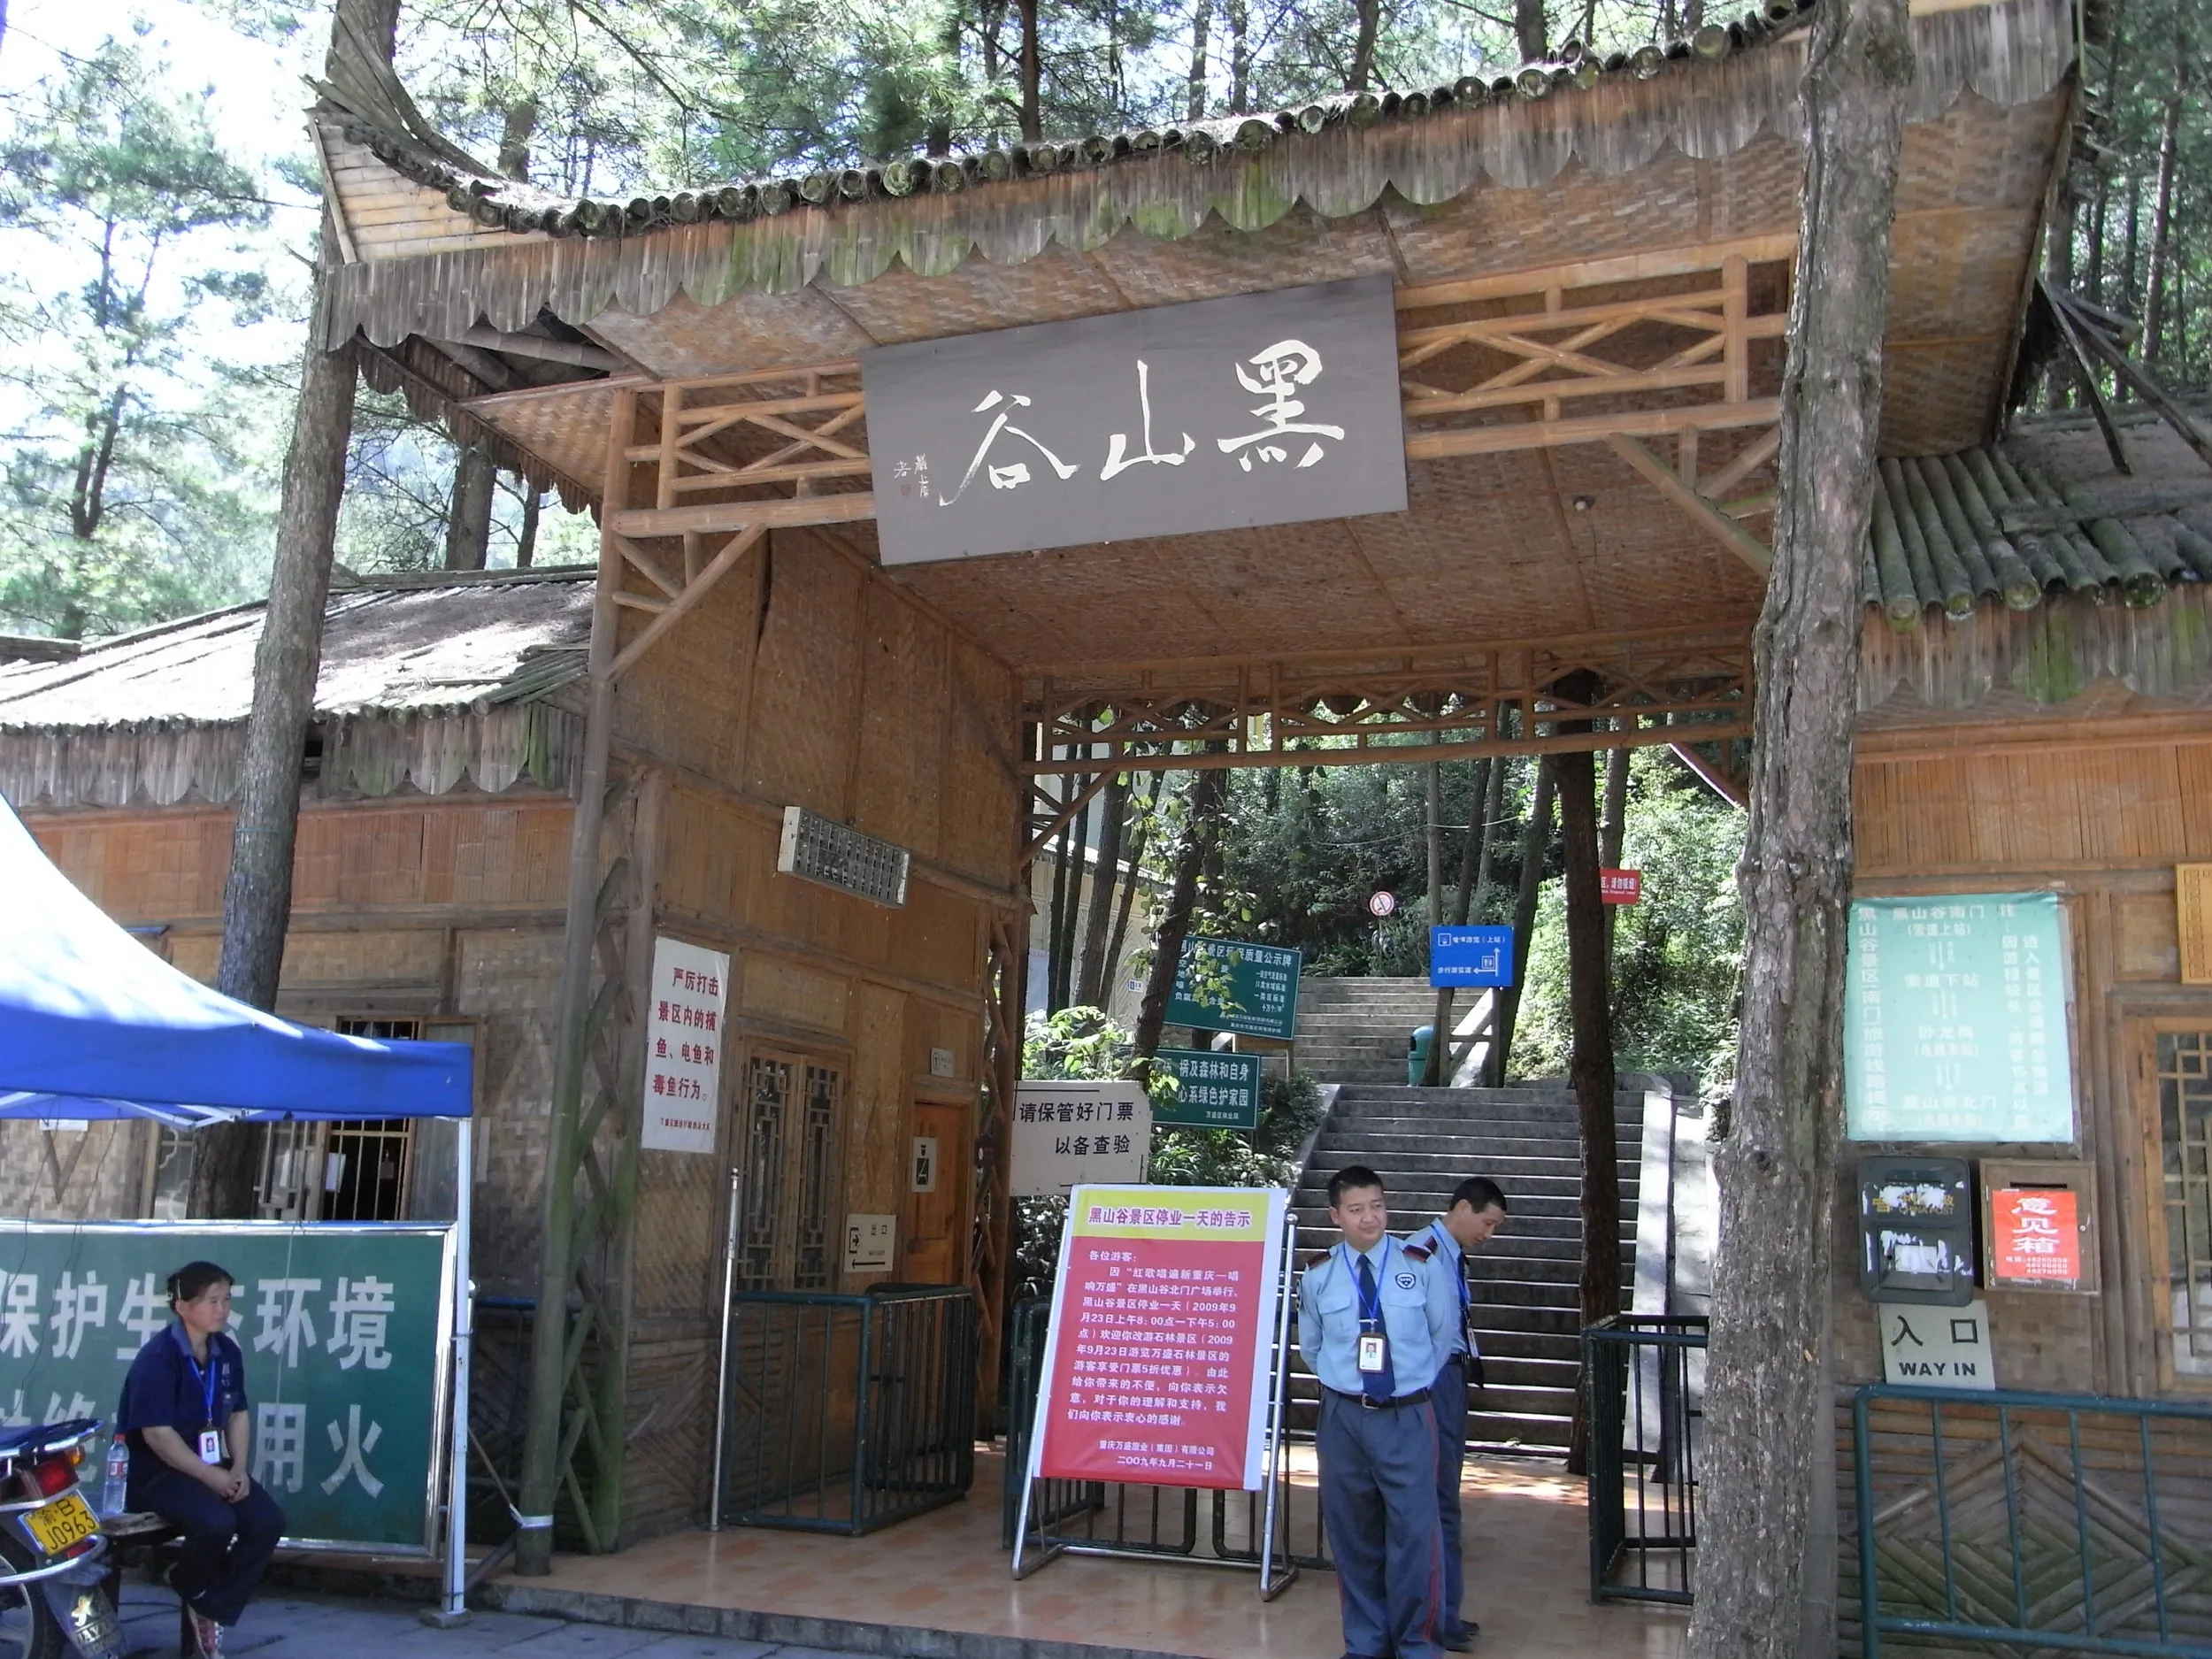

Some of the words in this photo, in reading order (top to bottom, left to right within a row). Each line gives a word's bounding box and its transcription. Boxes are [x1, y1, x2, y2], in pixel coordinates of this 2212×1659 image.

[939, 339, 1345, 507] 黑山谷
[672, 967, 718, 997] 严厉打击
[658, 1001, 717, 1032] 景区内的捕
[656, 1037, 714, 1065] 鱼、电鱼和
[1179, 1085, 1248, 1107] 心系绿色护家园
[1019, 1101, 1134, 1123] 请保管好门票
[1055, 1134, 1131, 1156] 以备查验
[1088, 1207, 1250, 1227] 黑山谷景区停业一天的告示
[2011, 1197, 2060, 1254] 意见箱
[0, 1271, 395, 1371] 保护生环境
[1899, 1363, 1946, 1376] WAY
[1954, 1363, 1976, 1376] IN
[48, 1510, 96, 1550] J0963
